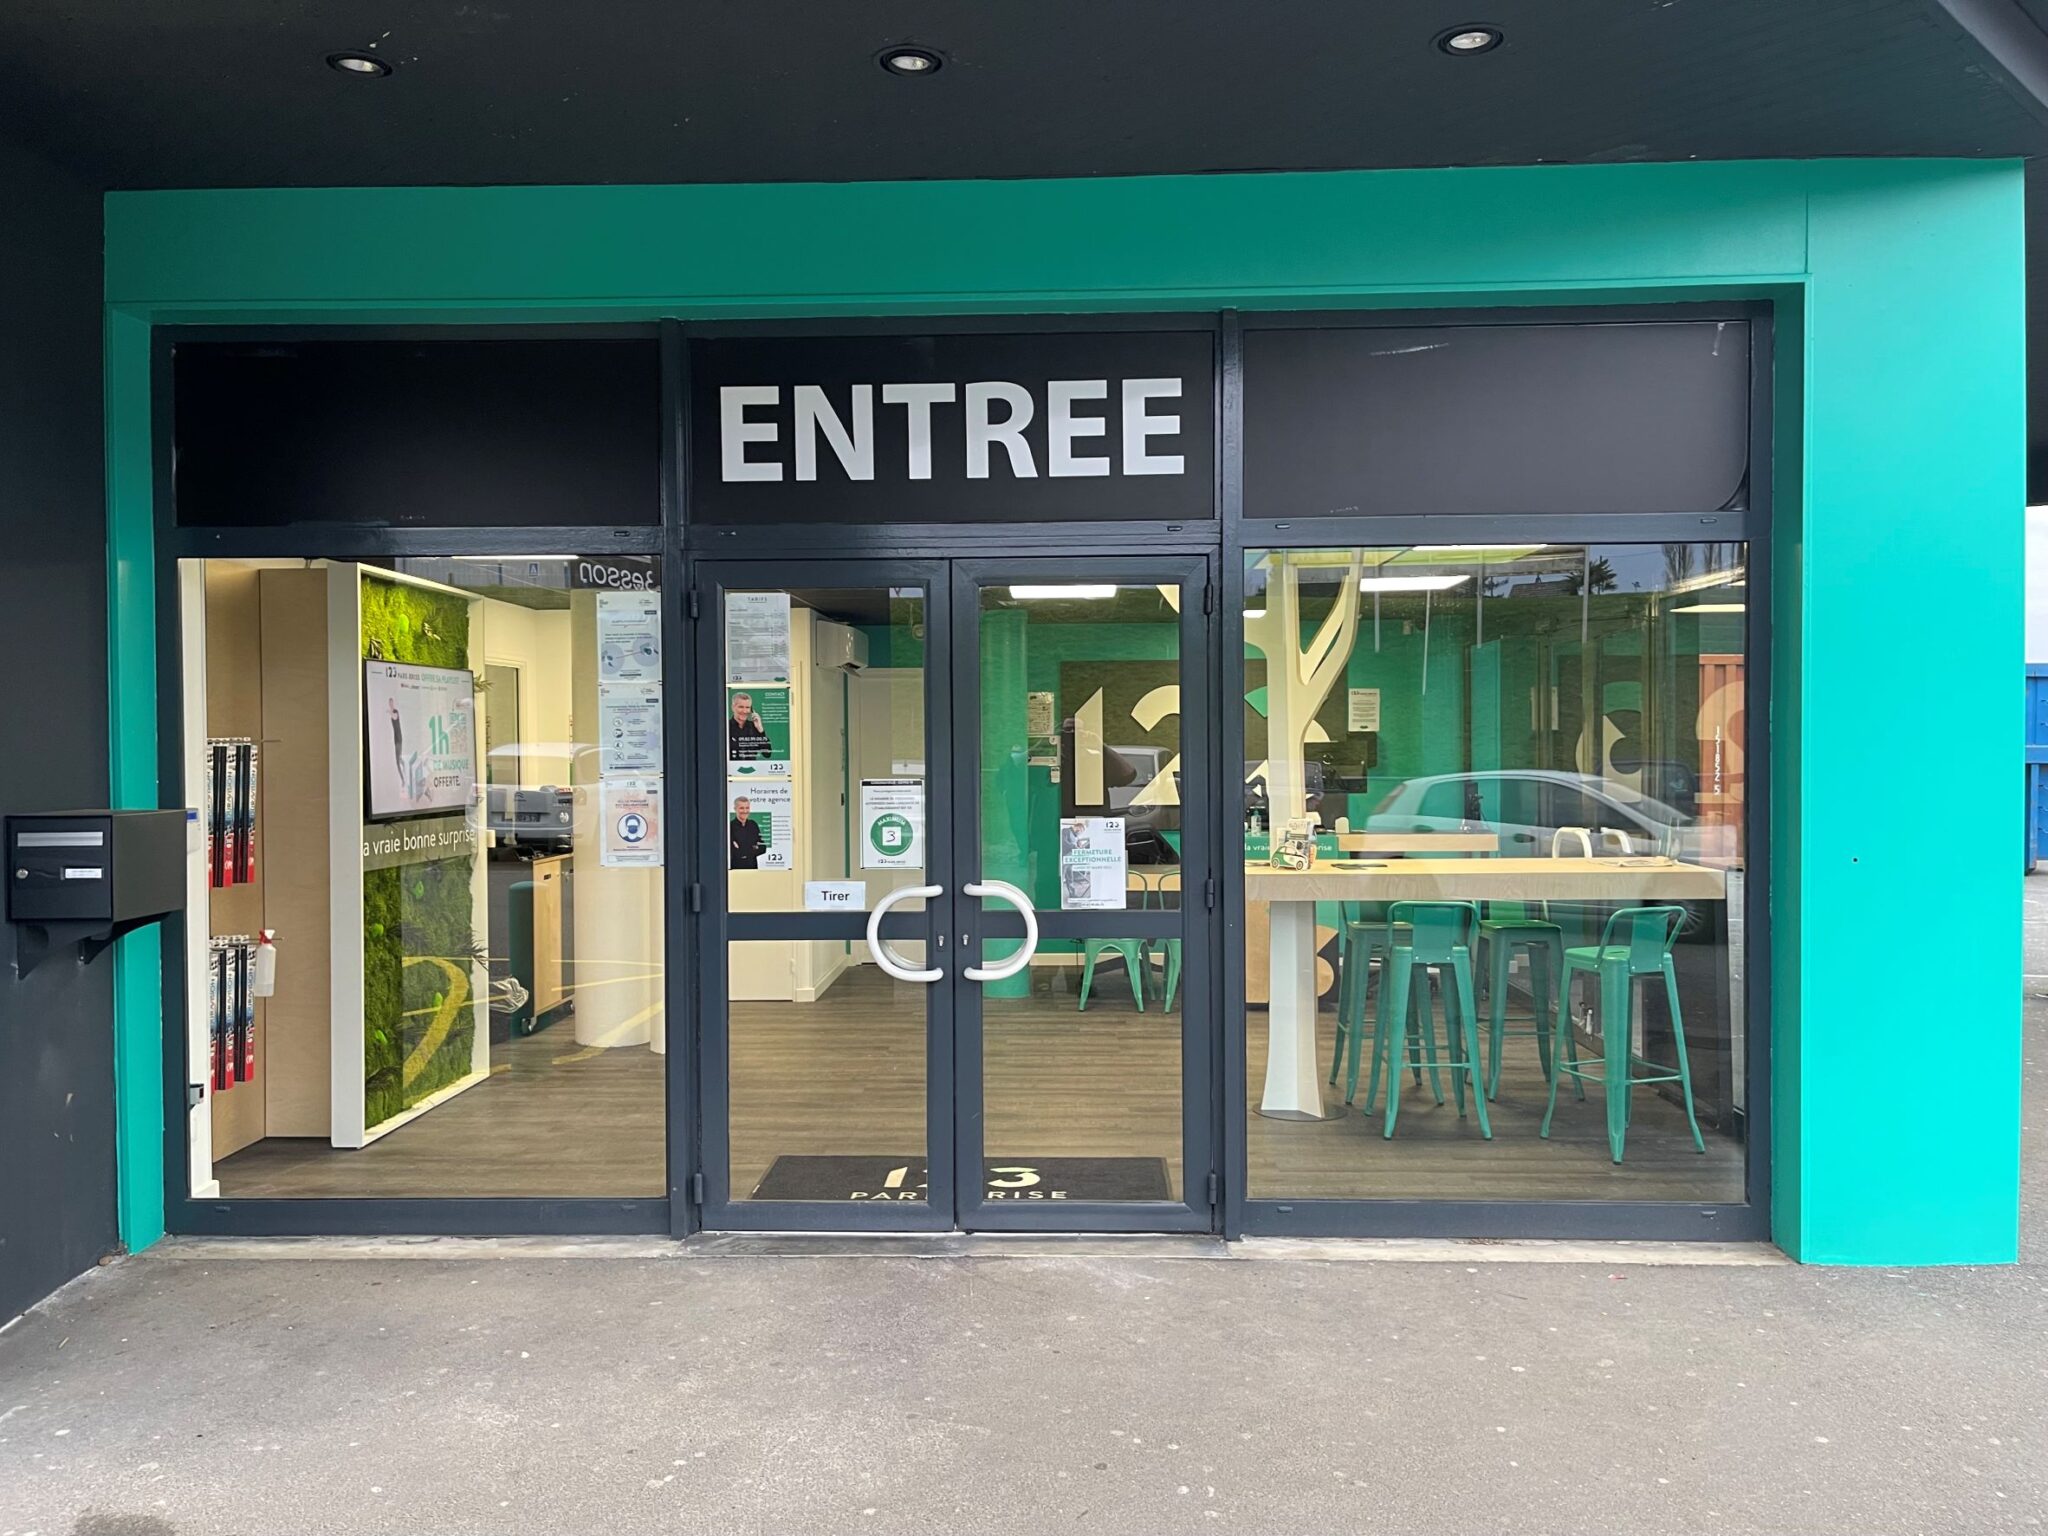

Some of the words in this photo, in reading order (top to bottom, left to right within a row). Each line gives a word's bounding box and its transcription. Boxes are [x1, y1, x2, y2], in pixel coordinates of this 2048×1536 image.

[720, 378, 1185, 482] ENTREE
[385, 666, 397, 678] 123
[428, 714, 449, 755] 1h
[433, 776, 460, 788] OFFERTE
[877, 815, 906, 826] MAXIMUM
[373, 831, 400, 855] vraie
[403, 829, 436, 851] bonne
[438, 823, 475, 852] surprise
[886, 831, 896, 842] 3
[820, 890, 850, 901] Tirer
[883, 1166, 1041, 1188] 13
[850, 1191, 928, 1200] PAR
[986, 1191, 1068, 1199] RISE
